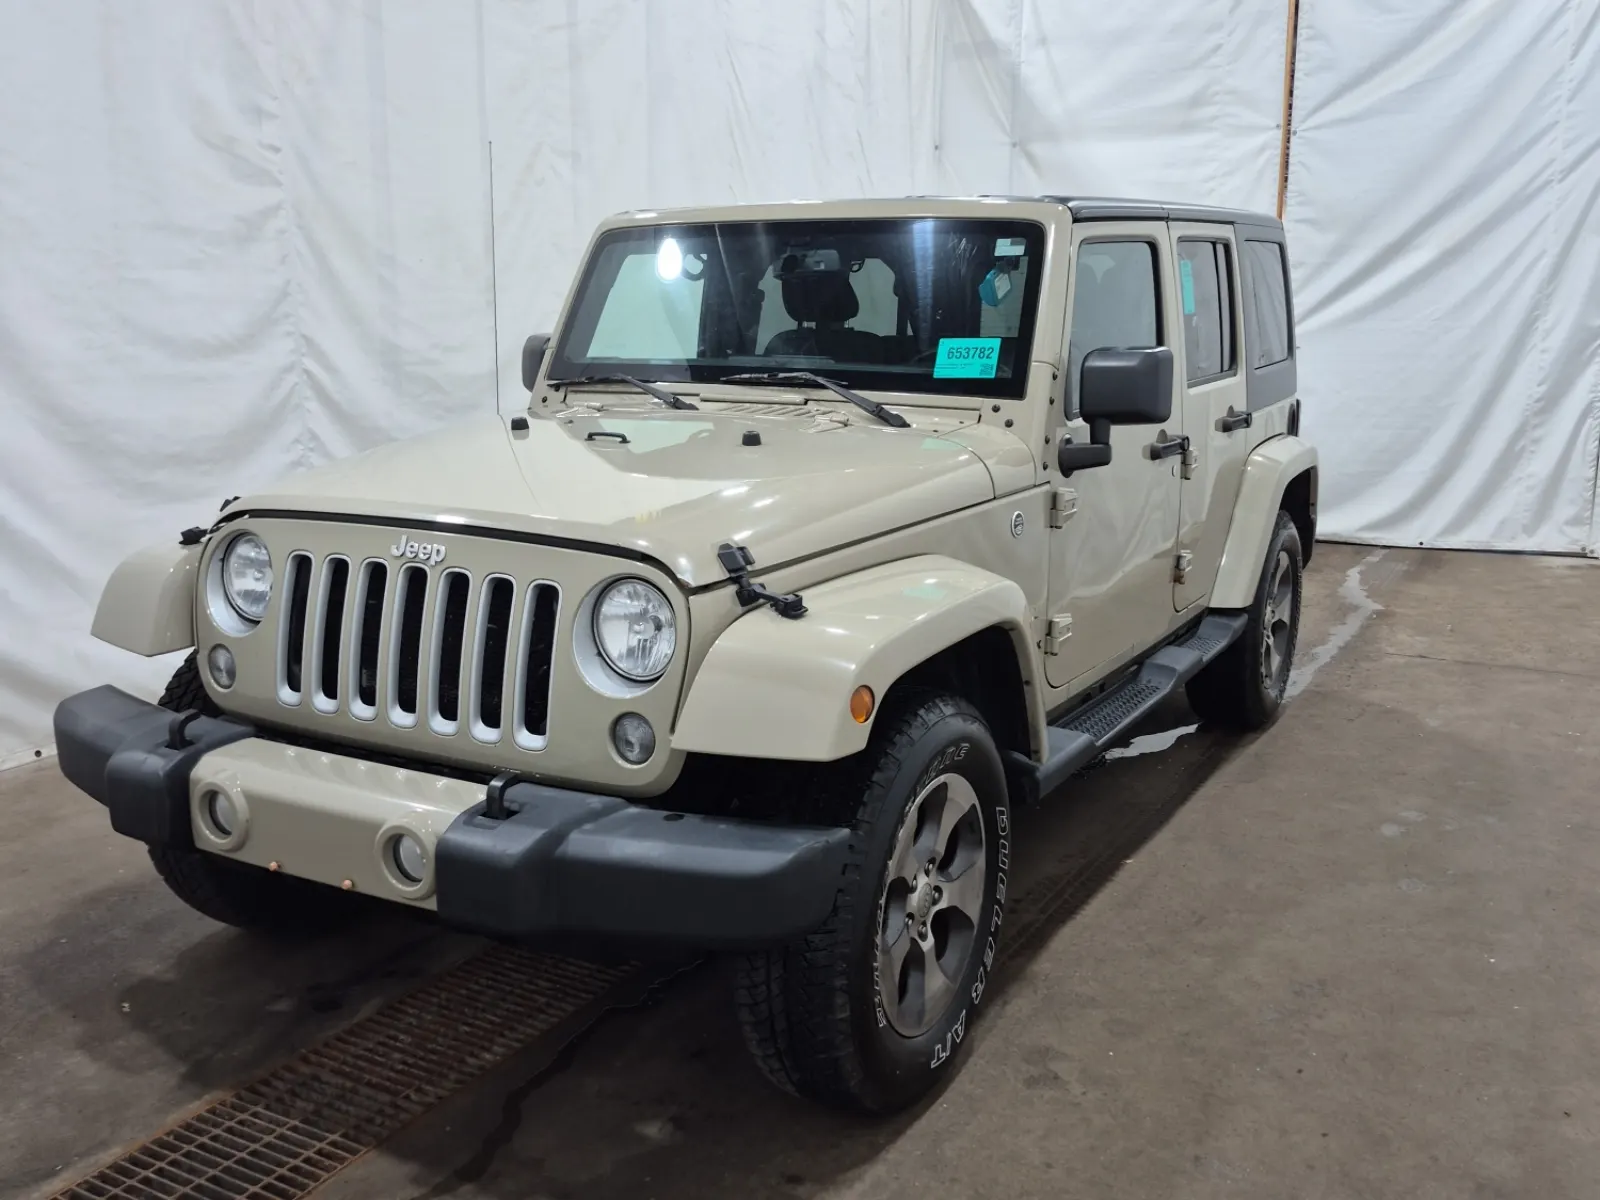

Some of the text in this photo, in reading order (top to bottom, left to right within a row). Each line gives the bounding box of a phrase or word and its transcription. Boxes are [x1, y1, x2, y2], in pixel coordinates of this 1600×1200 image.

[947, 346, 995, 360] 653782
[391, 534, 447, 566] Jeep
[971, 806, 1009, 1005] DUELER
